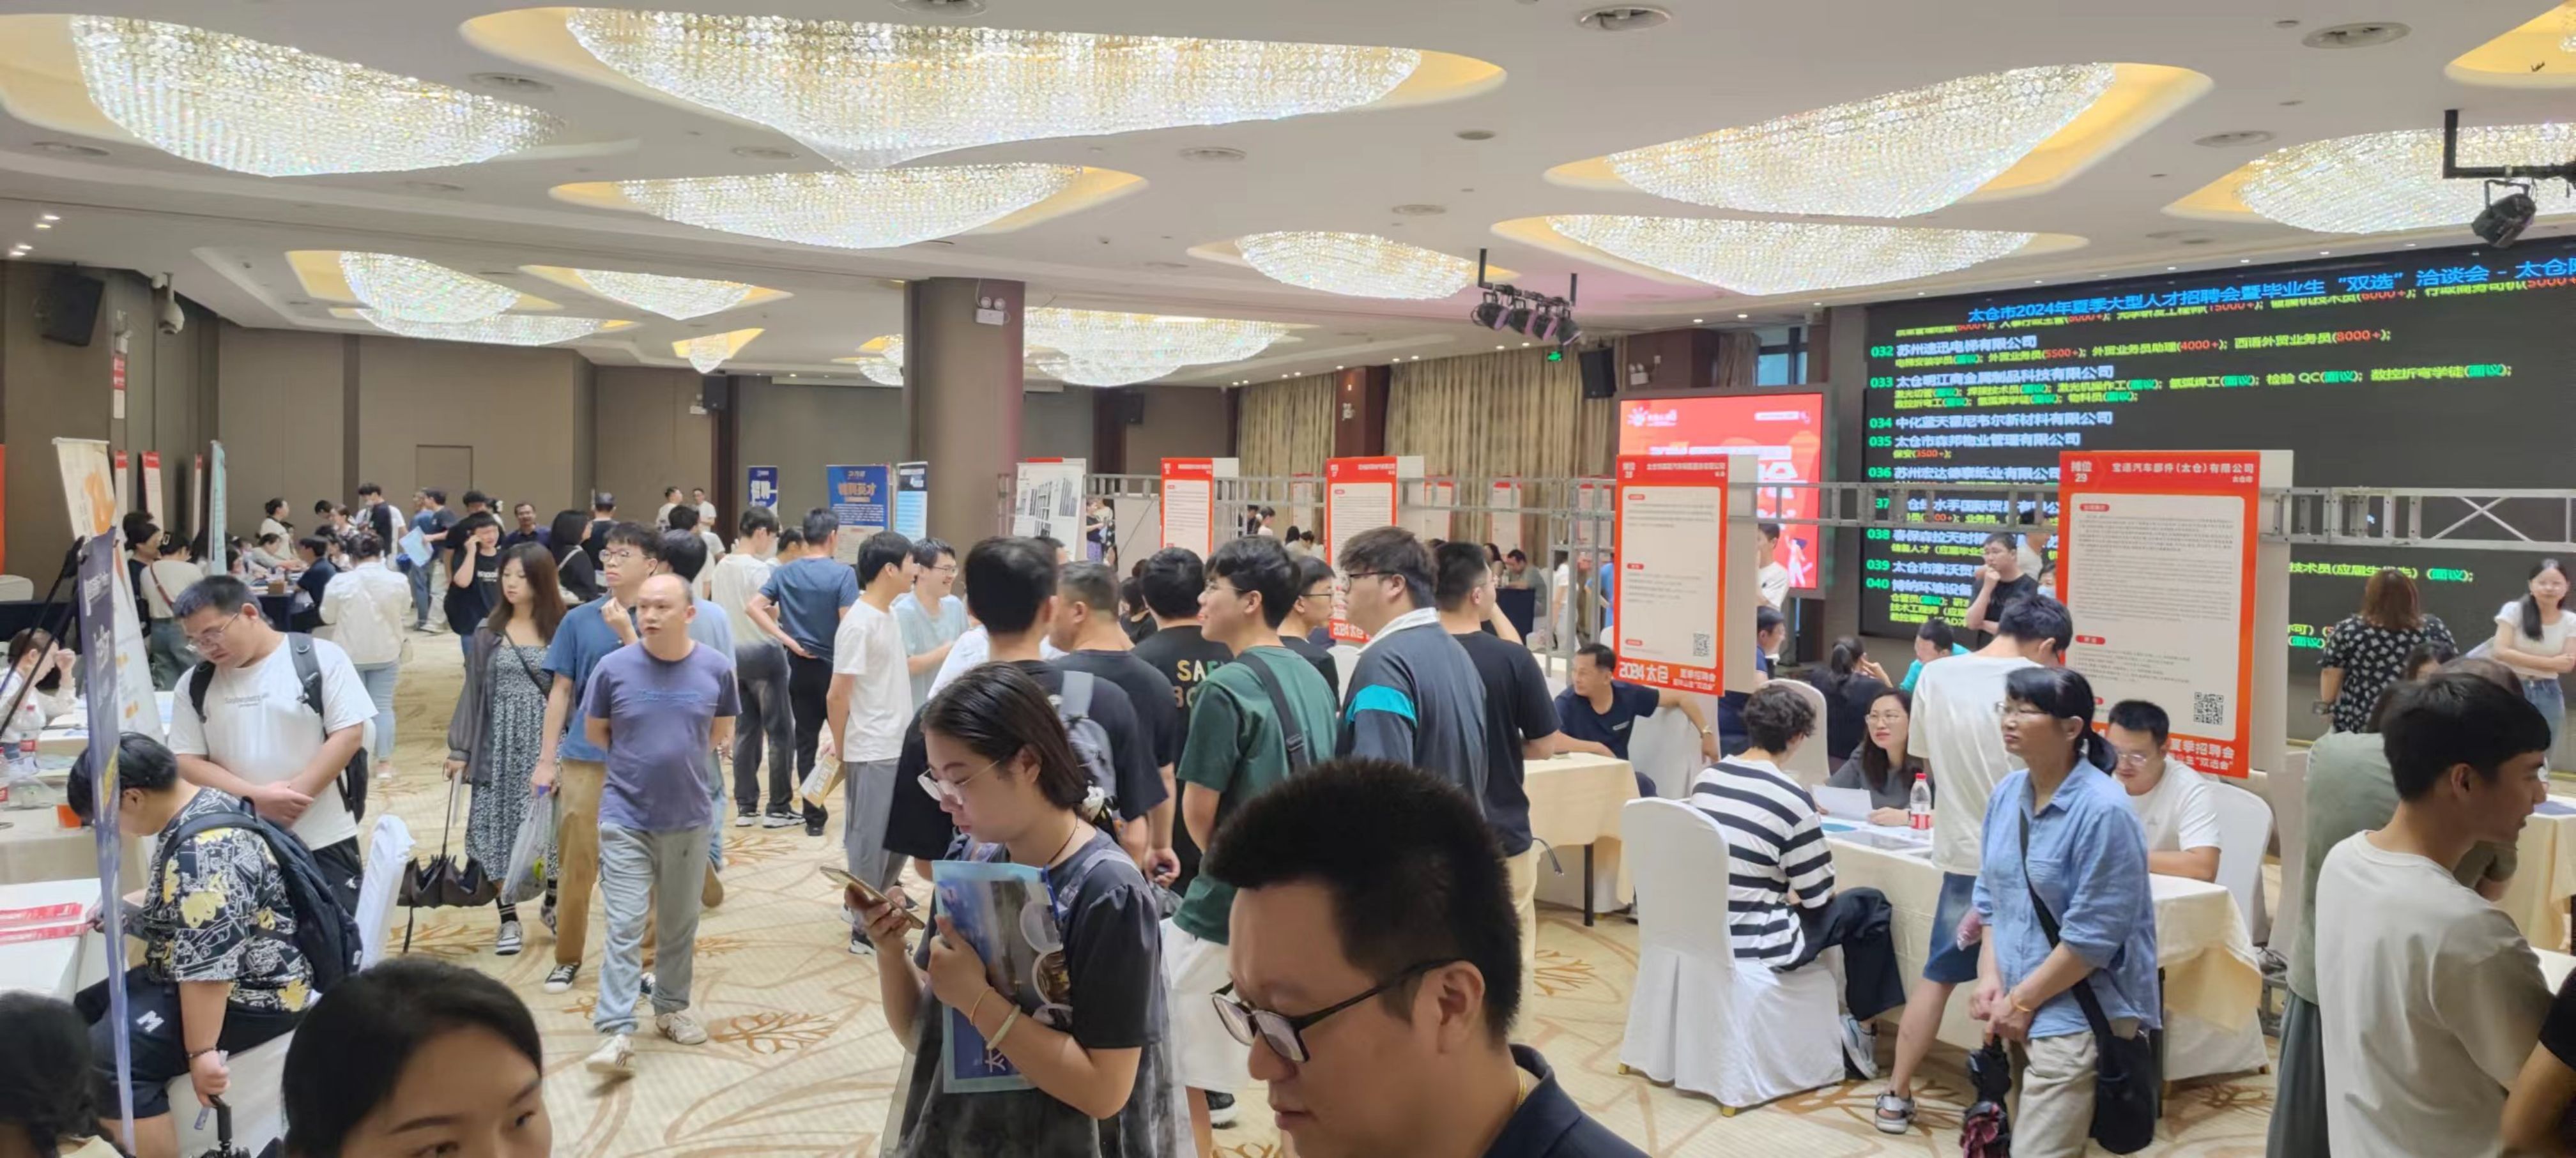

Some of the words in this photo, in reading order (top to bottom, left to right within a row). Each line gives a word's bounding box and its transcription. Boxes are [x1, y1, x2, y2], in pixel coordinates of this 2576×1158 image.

[1871, 346, 1894, 358] 032
[1870, 377, 1894, 388] 033
[1869, 418, 1892, 429] 034
[1869, 436, 1892, 447] 035
[1868, 467, 1892, 478] 036
[1874, 498, 1891, 509] 37
[1867, 529, 1891, 540] 038
[1866, 560, 1890, 570] 039
[1866, 579, 1890, 590] 040
